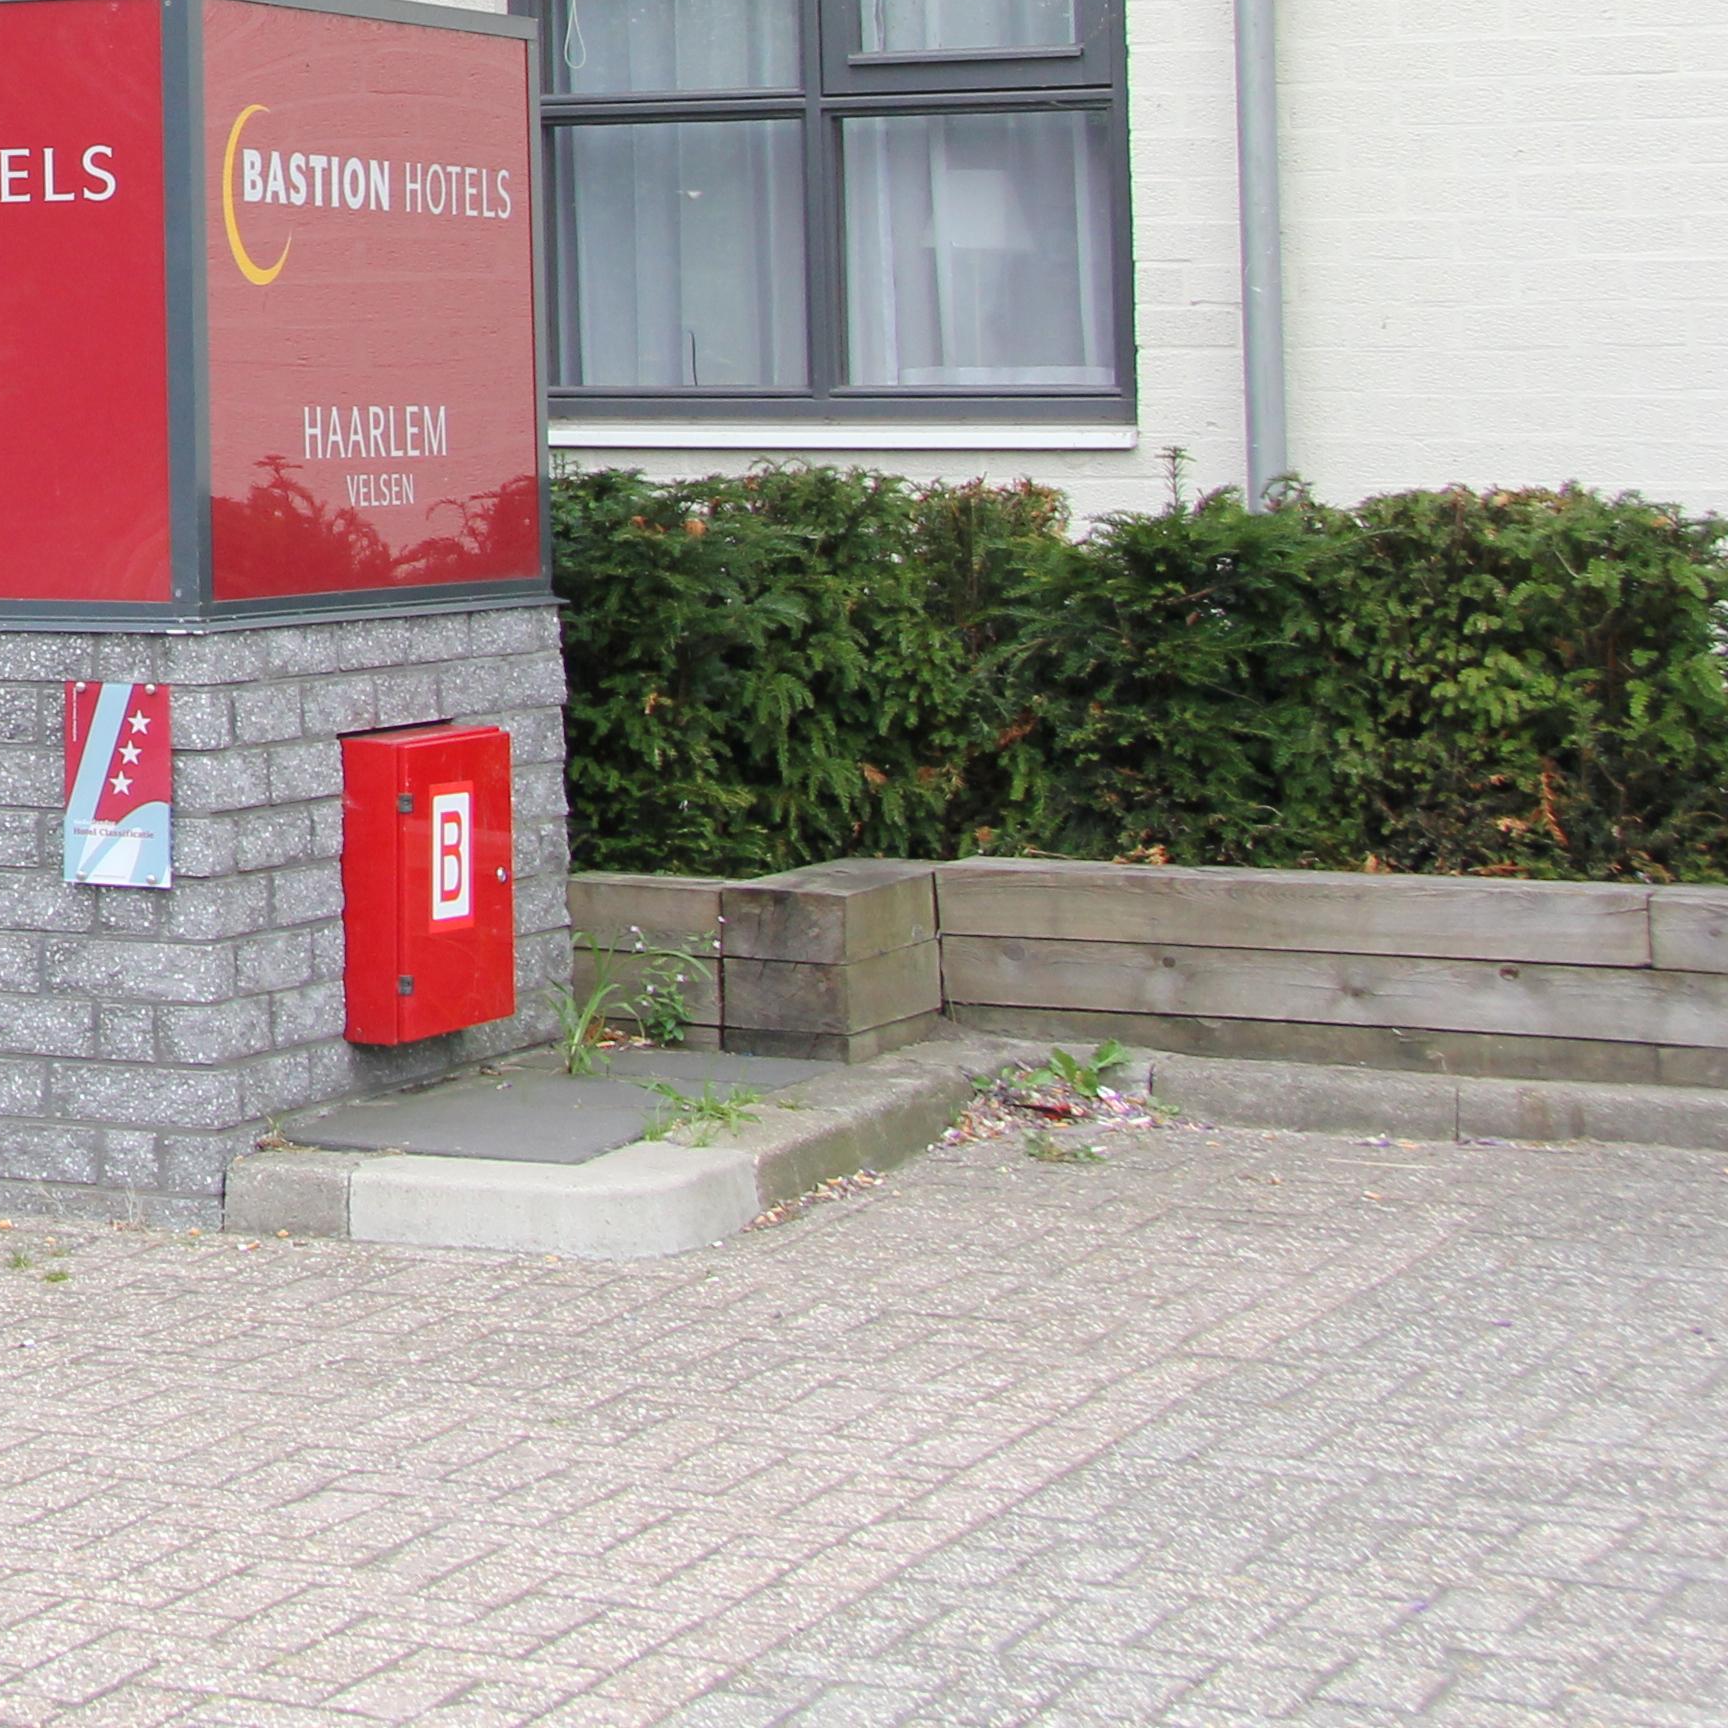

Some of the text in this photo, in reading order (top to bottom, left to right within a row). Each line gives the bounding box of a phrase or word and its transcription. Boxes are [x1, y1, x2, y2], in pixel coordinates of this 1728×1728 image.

[241, 147, 512, 220] BASTION HOTELS
[303, 404, 448, 460] HAARLEM
[346, 472, 415, 508] VELSEN
[440, 810, 462, 902] B
